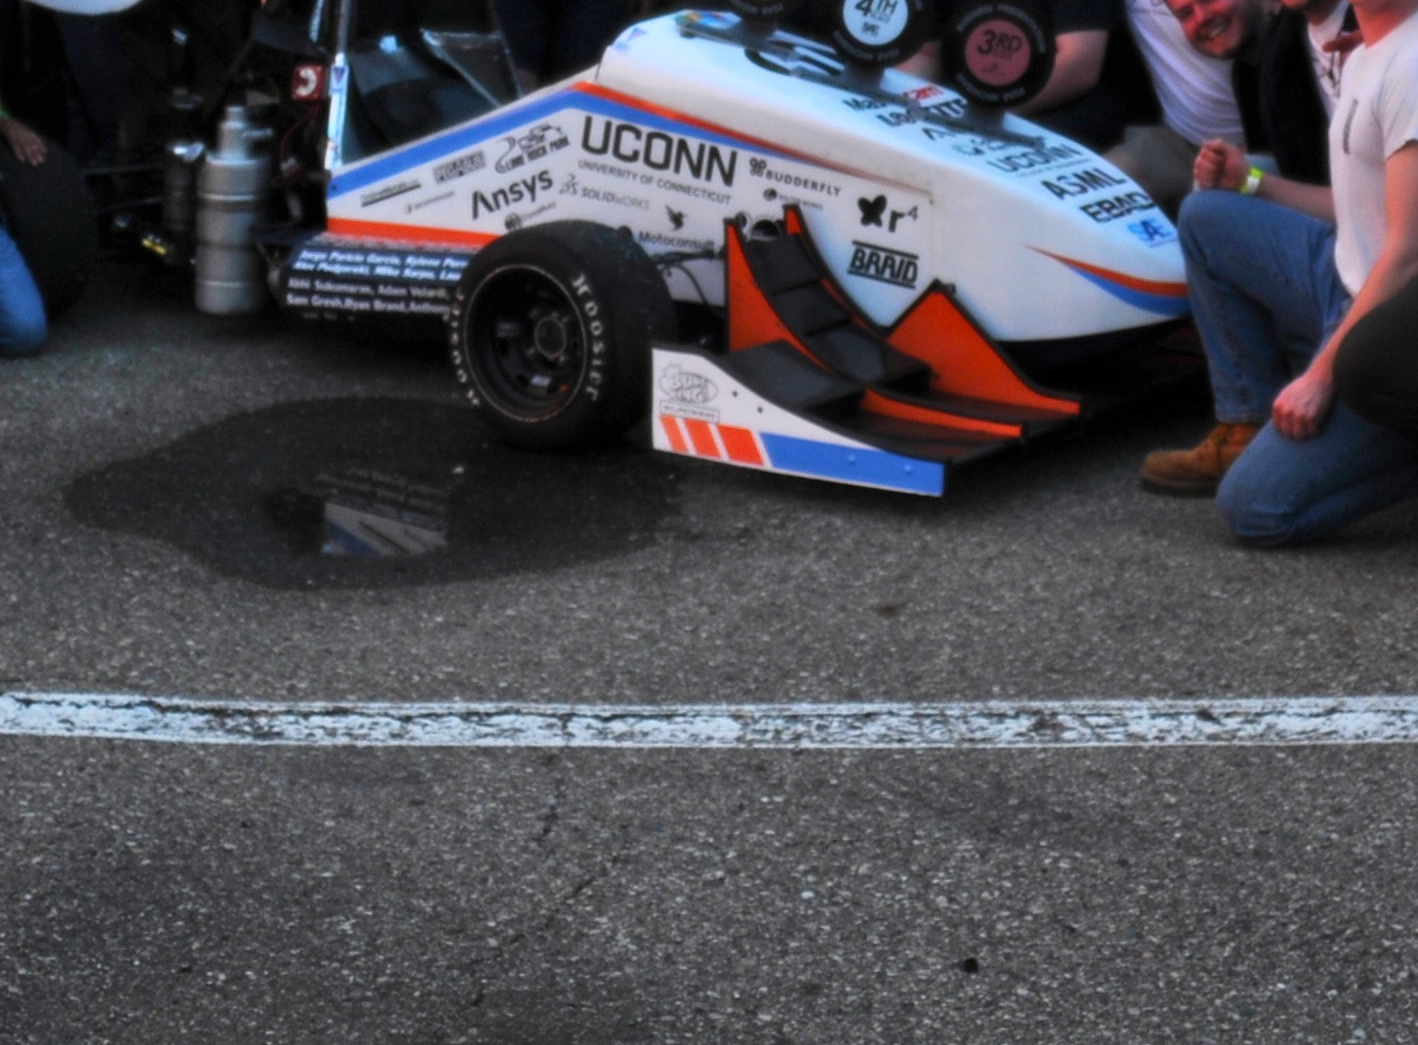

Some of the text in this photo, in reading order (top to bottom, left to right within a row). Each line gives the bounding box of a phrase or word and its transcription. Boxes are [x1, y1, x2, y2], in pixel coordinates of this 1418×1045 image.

[976, 28, 1022, 56] 3RD
[582, 115, 738, 187] UCONN
[472, 168, 555, 220] Ansys
[577, 159, 732, 205] UNIVERSITY OF CONNECTICUT
[765, 168, 842, 197] BUDDERFLY
[1040, 167, 1127, 202] ASML
[1079, 191, 1158, 224] EBAD
[850, 246, 919, 285] BRAID
[572, 273, 605, 402] HOOSIER
